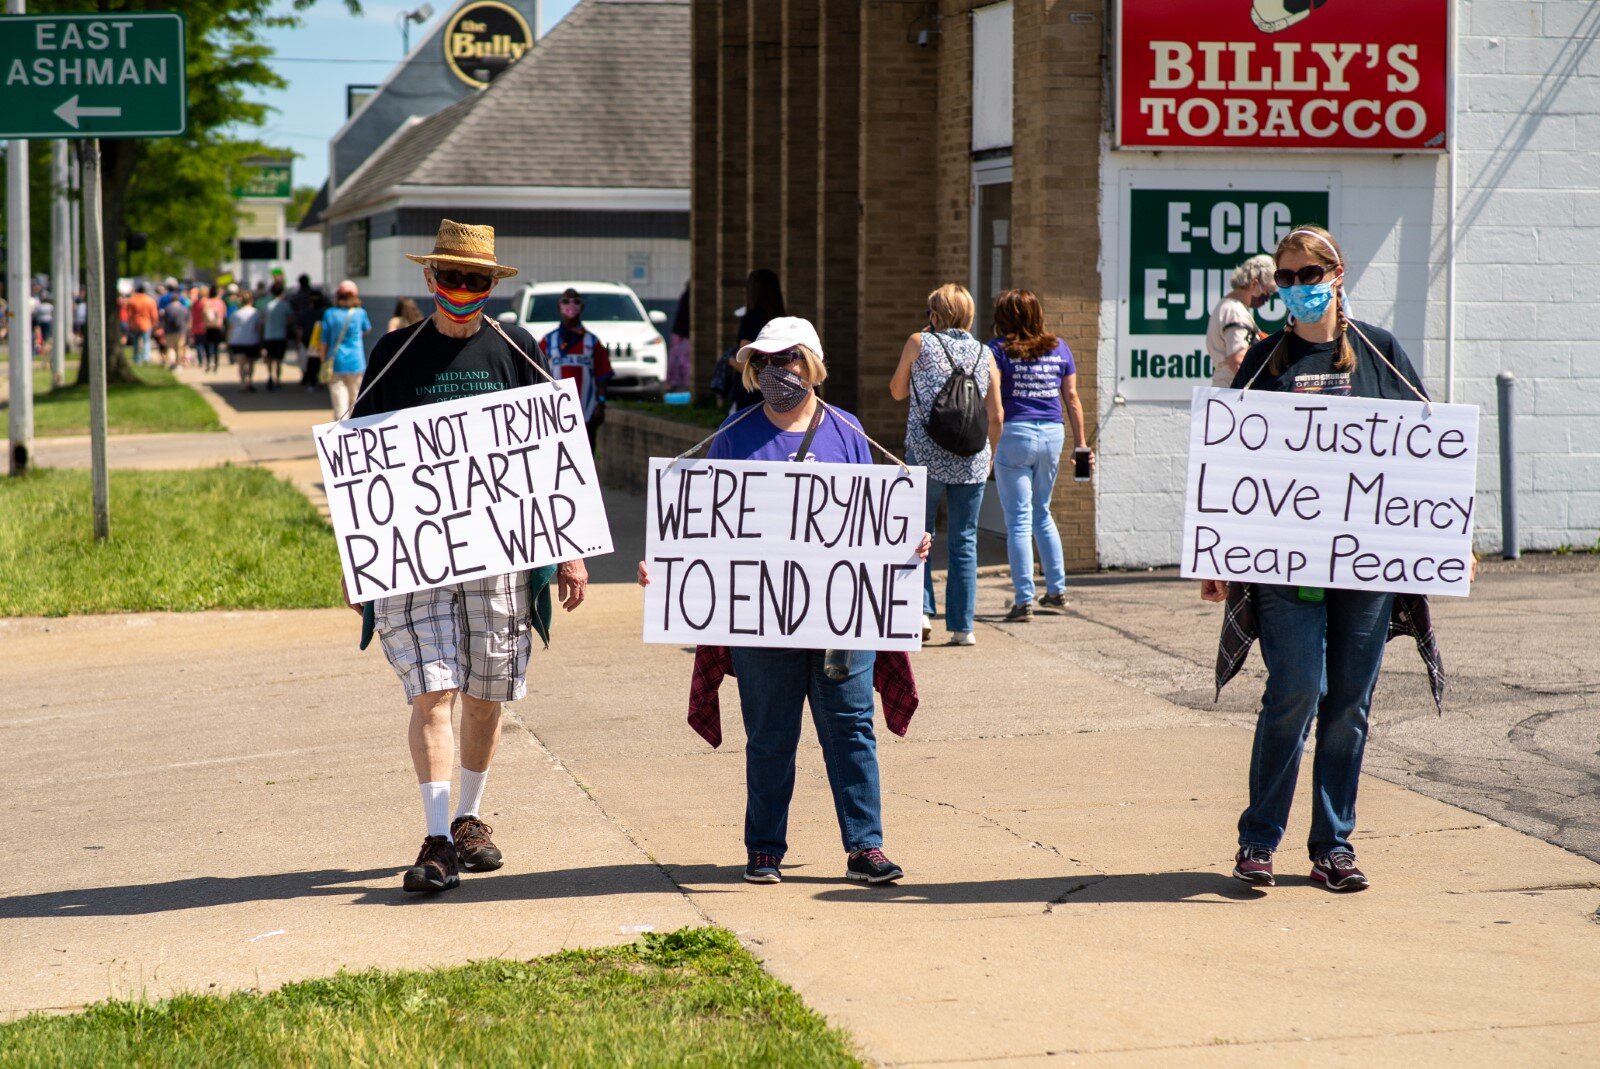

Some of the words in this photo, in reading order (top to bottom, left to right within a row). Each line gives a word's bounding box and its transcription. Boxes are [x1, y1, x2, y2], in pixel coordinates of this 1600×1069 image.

[36, 22, 133, 50] EAST
[453, 32, 526, 64] Bully
[6, 58, 167, 85] ASHMAN
[1149, 41, 1420, 93] BILLY'S
[1140, 97, 1427, 139] TOBACCO
[1168, 201, 1292, 255] E-CIG
[415, 382, 459, 396] UNITED
[461, 381, 508, 392] CHURCH
[435, 370, 489, 381] MIDLAND
[1294, 373, 1320, 382] UNITED
[1321, 372, 1350, 380] CHURCH
[1314, 379, 1350, 387] CHRIST
[319, 424, 405, 478] WE'RE
[413, 411, 468, 463] NOT
[482, 393, 578, 447] TRYING
[1204, 398, 1268, 451] Do
[1285, 406, 1468, 459] Justice
[334, 473, 394, 530] TO
[412, 445, 540, 516] START
[555, 441, 586, 490] A
[656, 465, 767, 541] WE'RE
[785, 472, 914, 548] TRYING
[1197, 463, 1321, 521] Love
[1344, 472, 1474, 535] Mercy
[345, 509, 486, 596] RACE
[486, 494, 603, 567] WAR...
[1192, 525, 1307, 582] Reap
[1330, 534, 1465, 583] Peace
[654, 557, 716, 631] TO
[729, 559, 811, 636] END
[826, 560, 919, 639] ONE.
